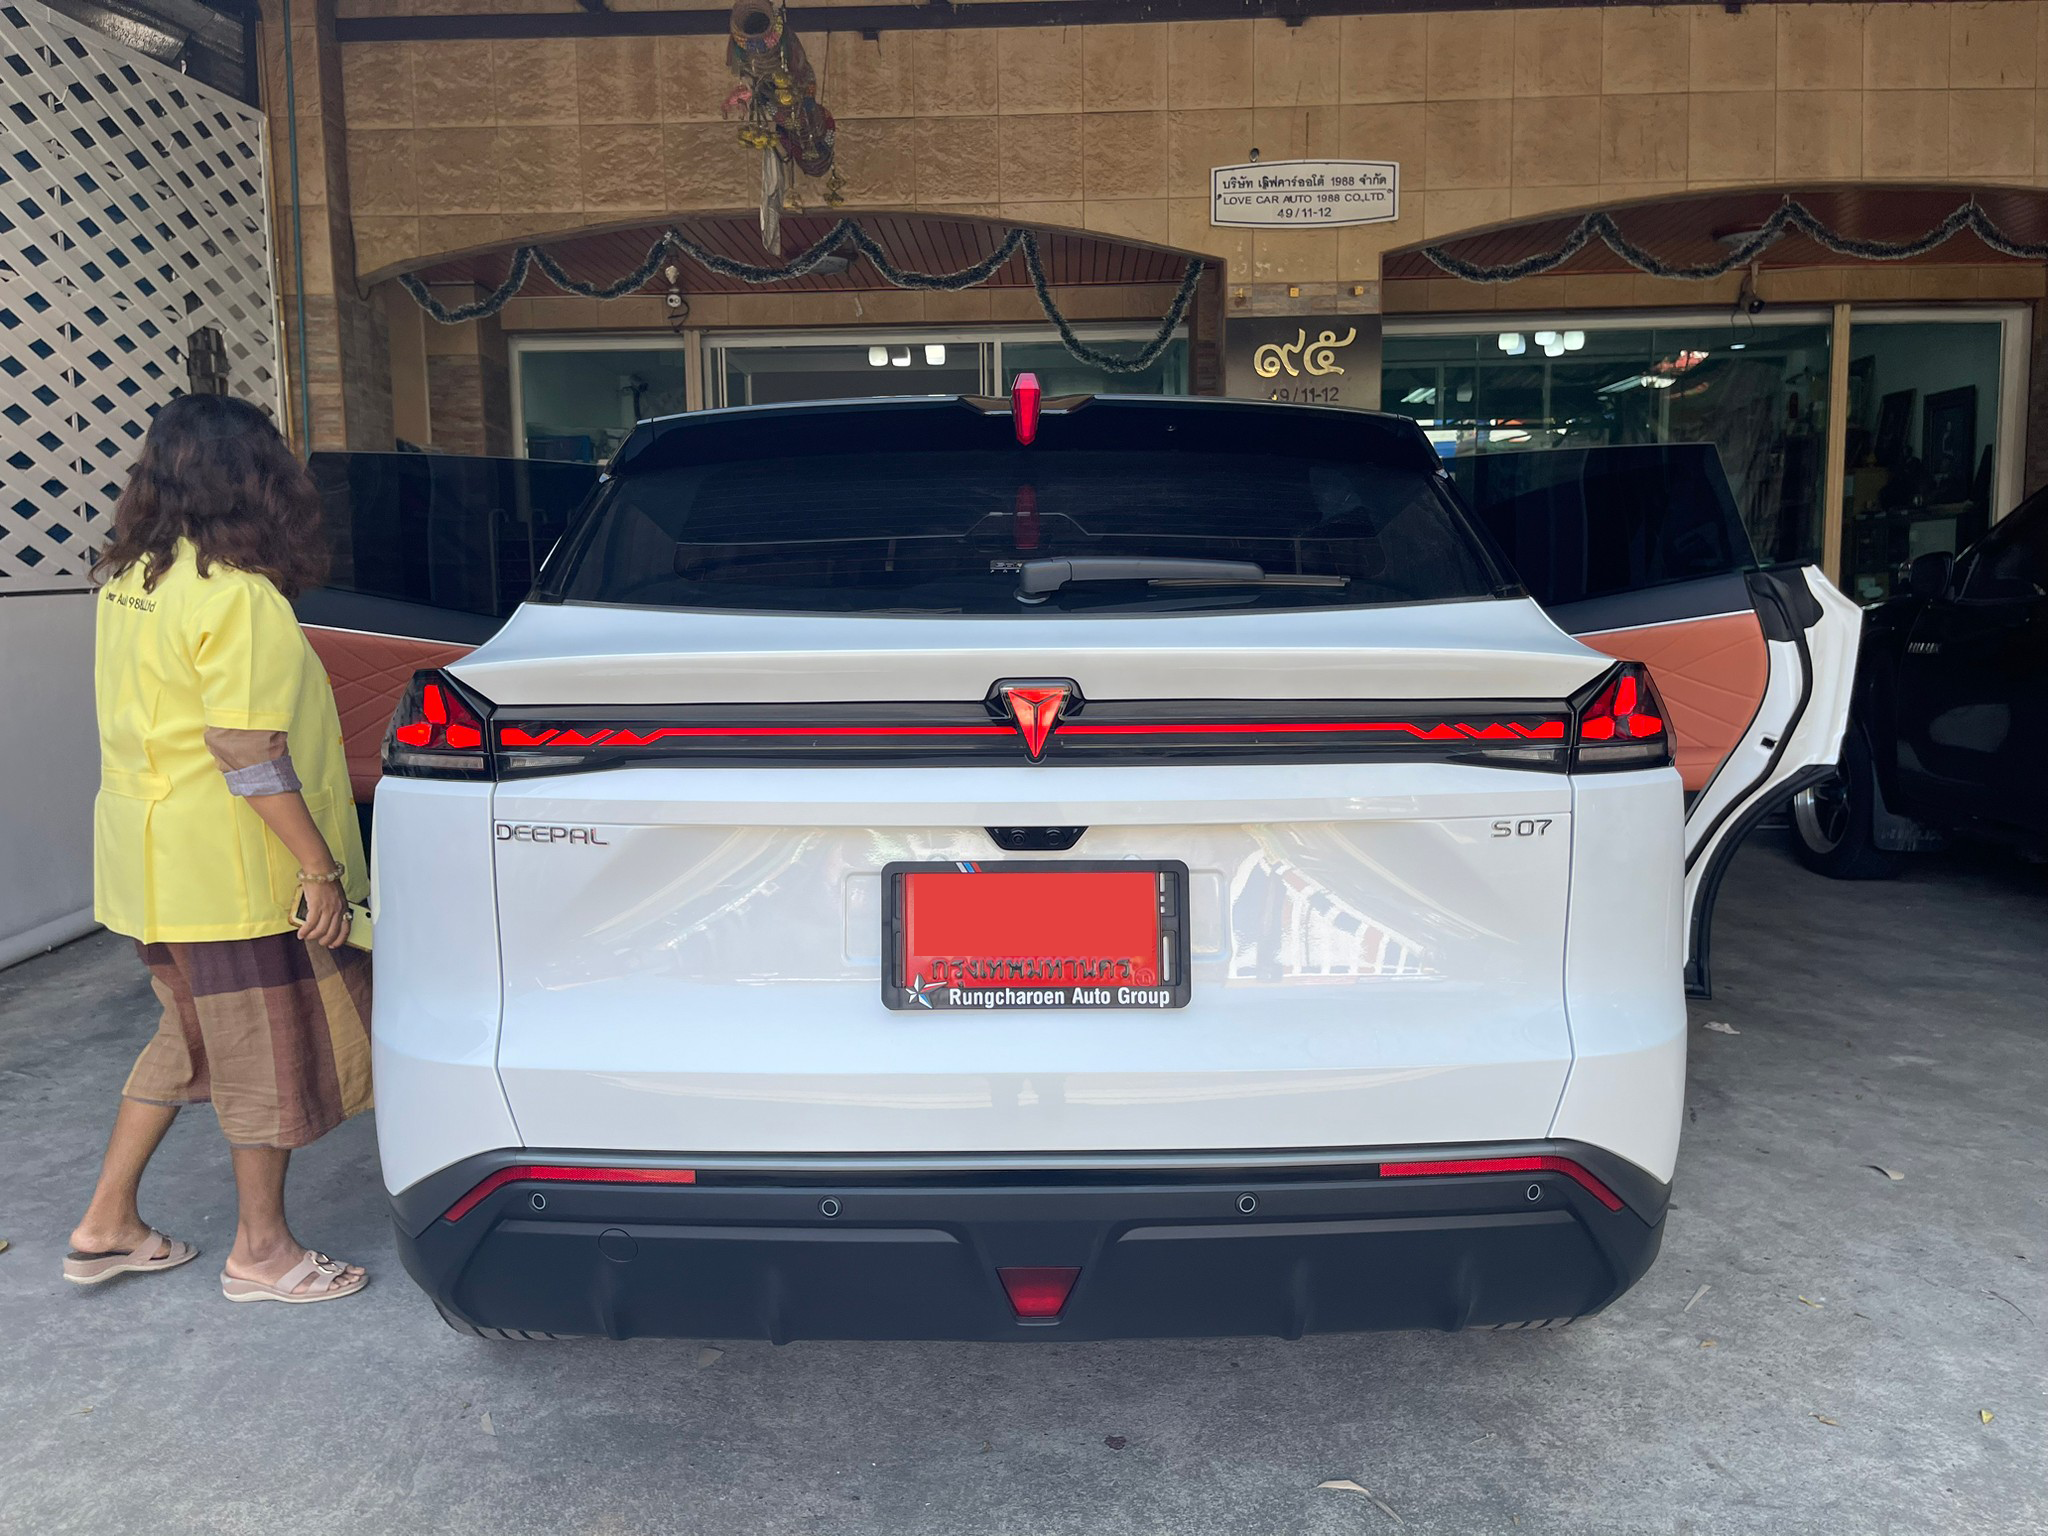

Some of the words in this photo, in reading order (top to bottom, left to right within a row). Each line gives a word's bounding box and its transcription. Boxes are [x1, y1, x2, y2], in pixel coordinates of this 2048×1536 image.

[1223, 175, 1254, 190] บริษัท
[1331, 176, 1355, 187] 1988
[1359, 172, 1387, 187] จำกัด
[1223, 195, 1252, 206] LOVE
[1256, 194, 1279, 205] CAR
[1282, 193, 1313, 204] AUTO
[1317, 193, 1341, 203] 1988
[1253, 327, 1357, 378] ๙๕
[496, 823, 610, 846] DEEPAL
[931, 957, 1131, 988] กรุงเทพมหานคร
[948, 987, 1065, 1008] Rungcharoen
[1071, 987, 1111, 1005] Auto
[1117, 986, 1171, 1008] Group
